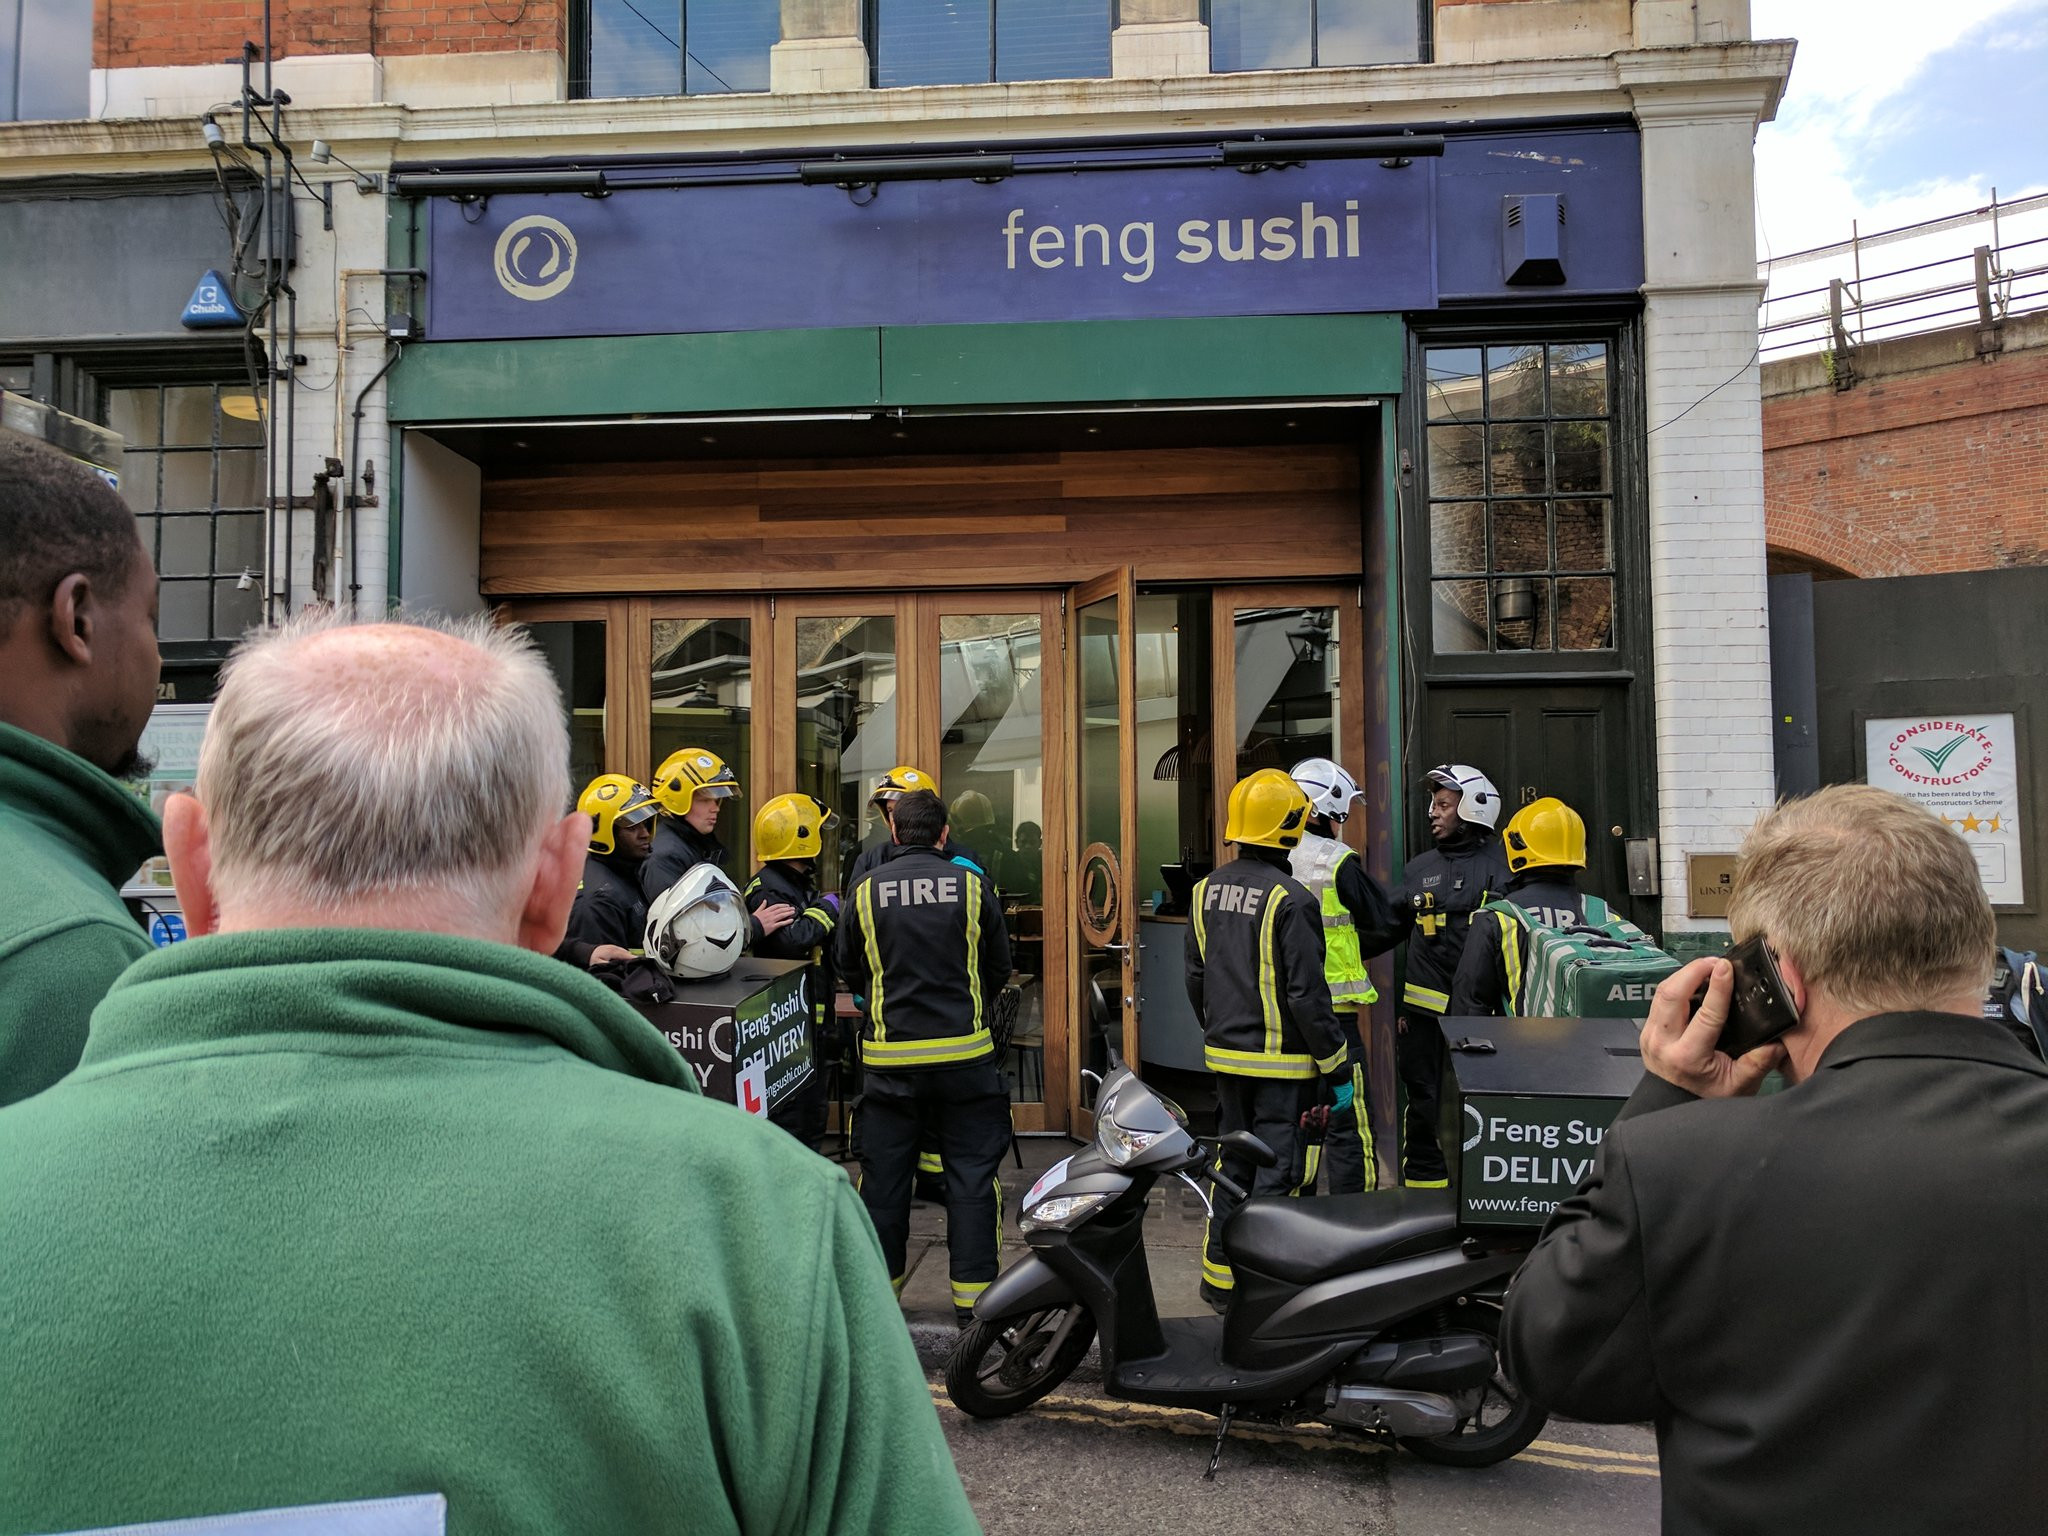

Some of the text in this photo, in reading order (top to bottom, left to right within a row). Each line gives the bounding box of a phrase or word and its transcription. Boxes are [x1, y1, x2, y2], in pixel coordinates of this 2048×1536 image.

[1002, 200, 1360, 283] feng sushi
[190, 304, 225, 314] Chubb
[1889, 721, 1993, 752] CONSIDERATE
[1889, 756, 1993, 786] CONSTRUCTORS
[1520, 786, 1537, 803] 13
[1972, 790, 1981, 799] by
[1974, 798, 2003, 806] Scheme
[879, 877, 959, 908] FIRE
[1204, 884, 1264, 915] FIRE
[741, 989, 800, 1045] Feng Sushi
[1489, 1117, 1609, 1149] Feng Su
